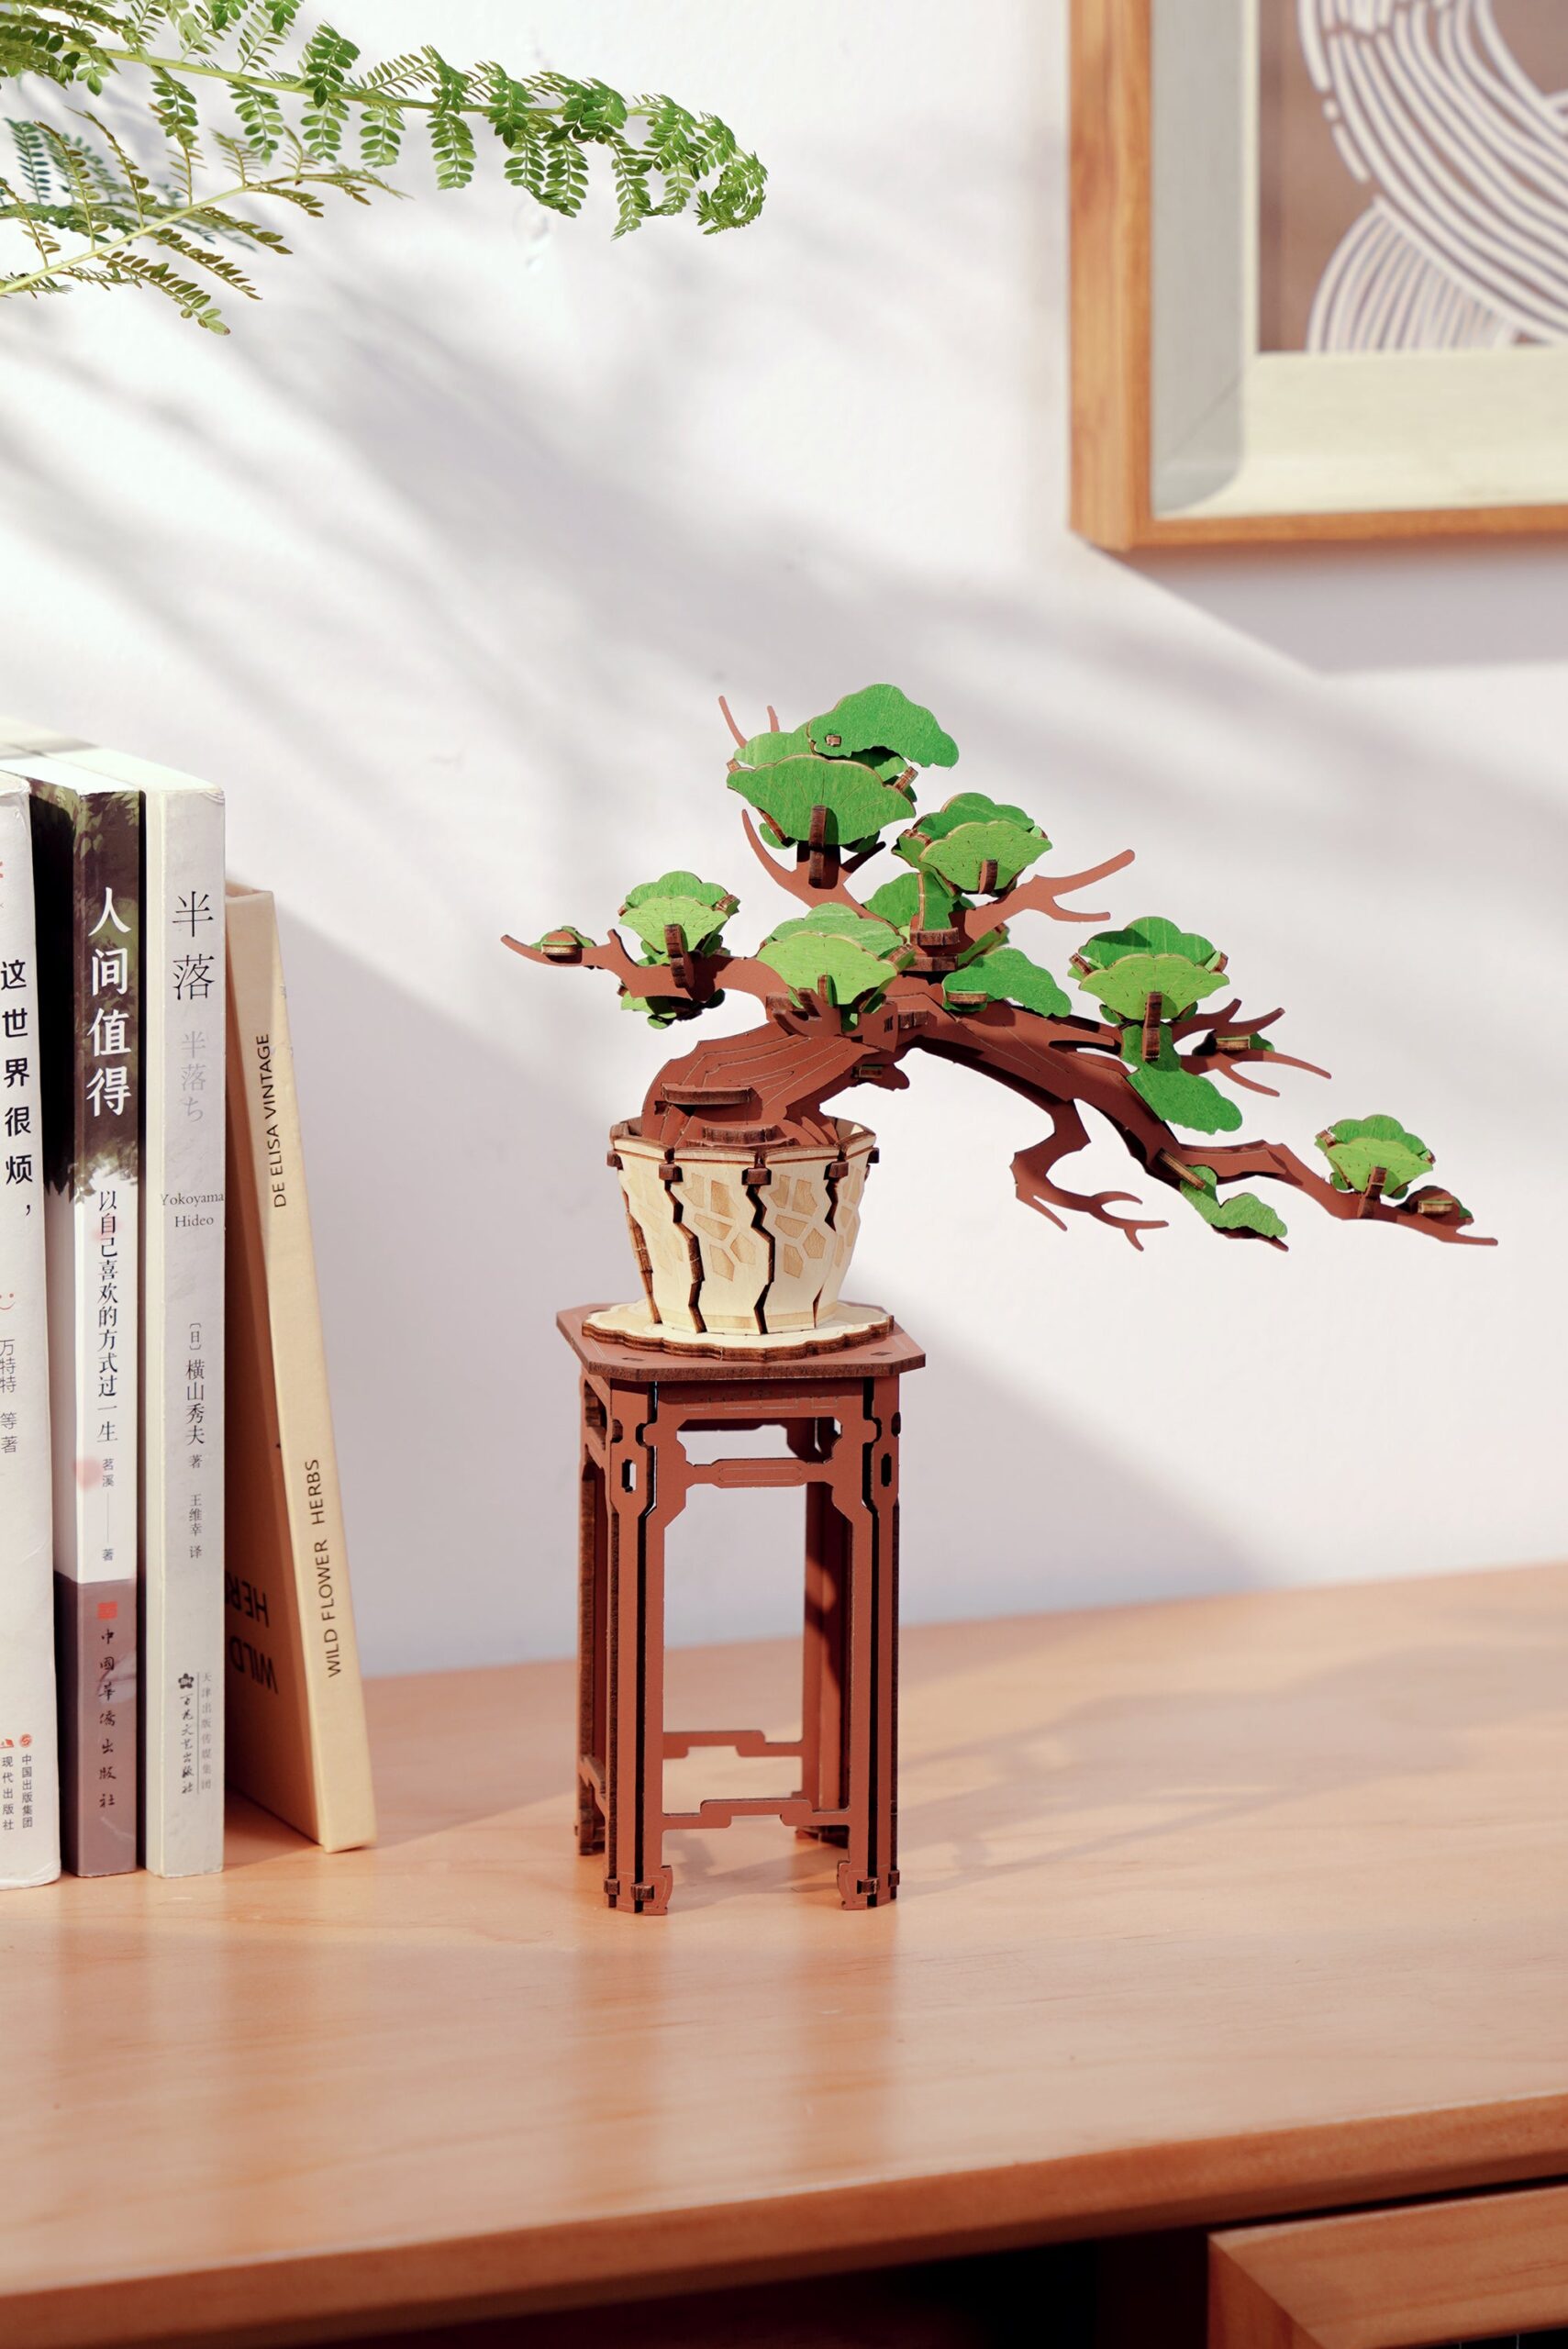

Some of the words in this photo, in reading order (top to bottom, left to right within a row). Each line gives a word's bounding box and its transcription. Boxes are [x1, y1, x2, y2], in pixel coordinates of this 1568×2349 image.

[172, 890, 216, 1001] 半落
[86, 886, 132, 1118] 人间值得
[1, 959, 33, 1217] 这世界很烦，
[181, 1030, 207, 1123] 半落ち
[256, 1033, 278, 1119] VINTAGE
[266, 1124, 284, 1176] ELISA
[161, 1192, 225, 1208] Yokoyama
[174, 1213, 215, 1228] Hideo
[272, 1181, 287, 1208] DE
[96, 1190, 118, 1443] 以自己喜欢的方式过一生
[185, 1359, 206, 1447] 横山秀夫
[305, 1459, 325, 1525] HERBS
[225, 1570, 270, 1629] HER
[314, 1539, 337, 1621] FLOWER
[324, 1628, 341, 1678] WILD
[2, 1755, 16, 1831] 现代出版社
[21, 1753, 33, 1829] 中国出版集团
